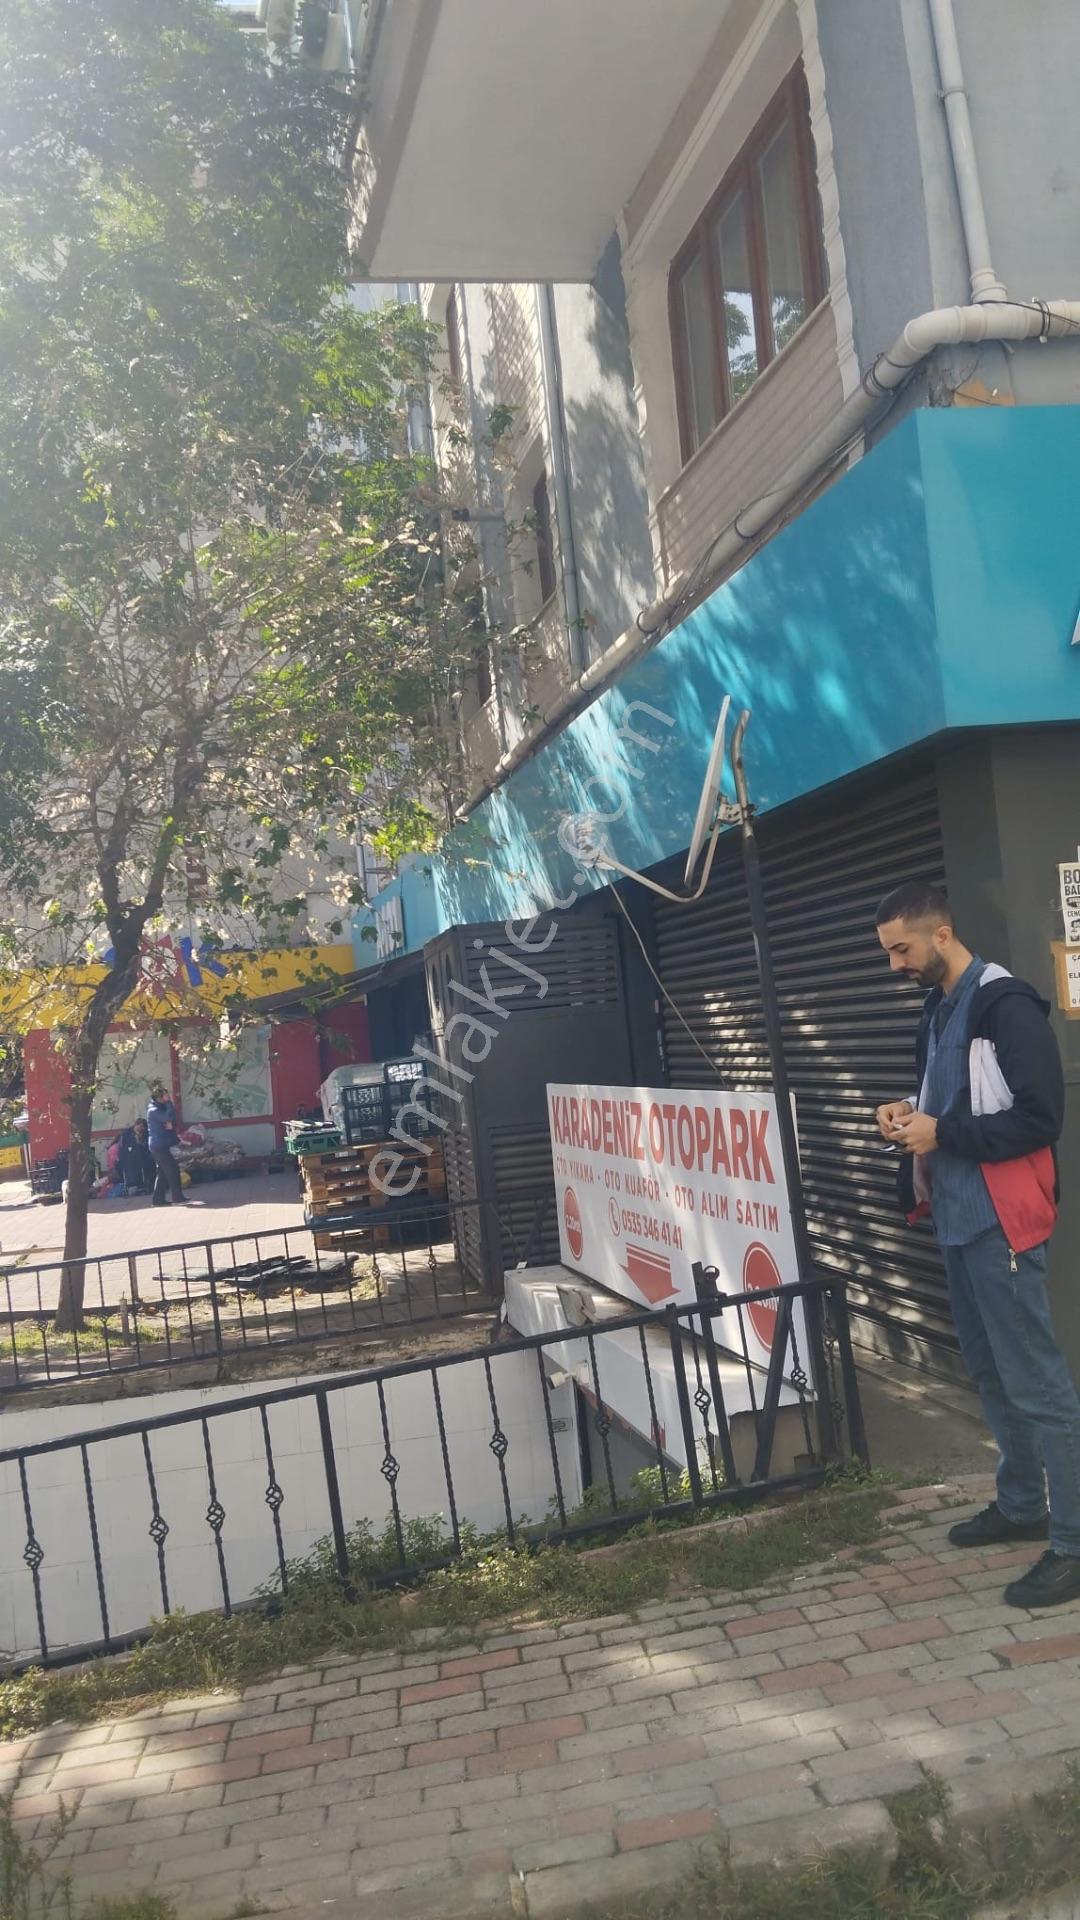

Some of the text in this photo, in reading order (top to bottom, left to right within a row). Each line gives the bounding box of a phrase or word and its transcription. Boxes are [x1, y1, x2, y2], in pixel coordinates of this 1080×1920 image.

[648, 1102, 776, 1185] OTOPARK
[604, 1170, 621, 1192] OTO
[625, 1173, 660, 1207] KUAFÖR
[674, 1186, 695, 1212] OTO
[701, 1191, 729, 1221] ALIM
[736, 1199, 780, 1233] SATIM
[621, 1208, 683, 1250] 0535 346 41 41
